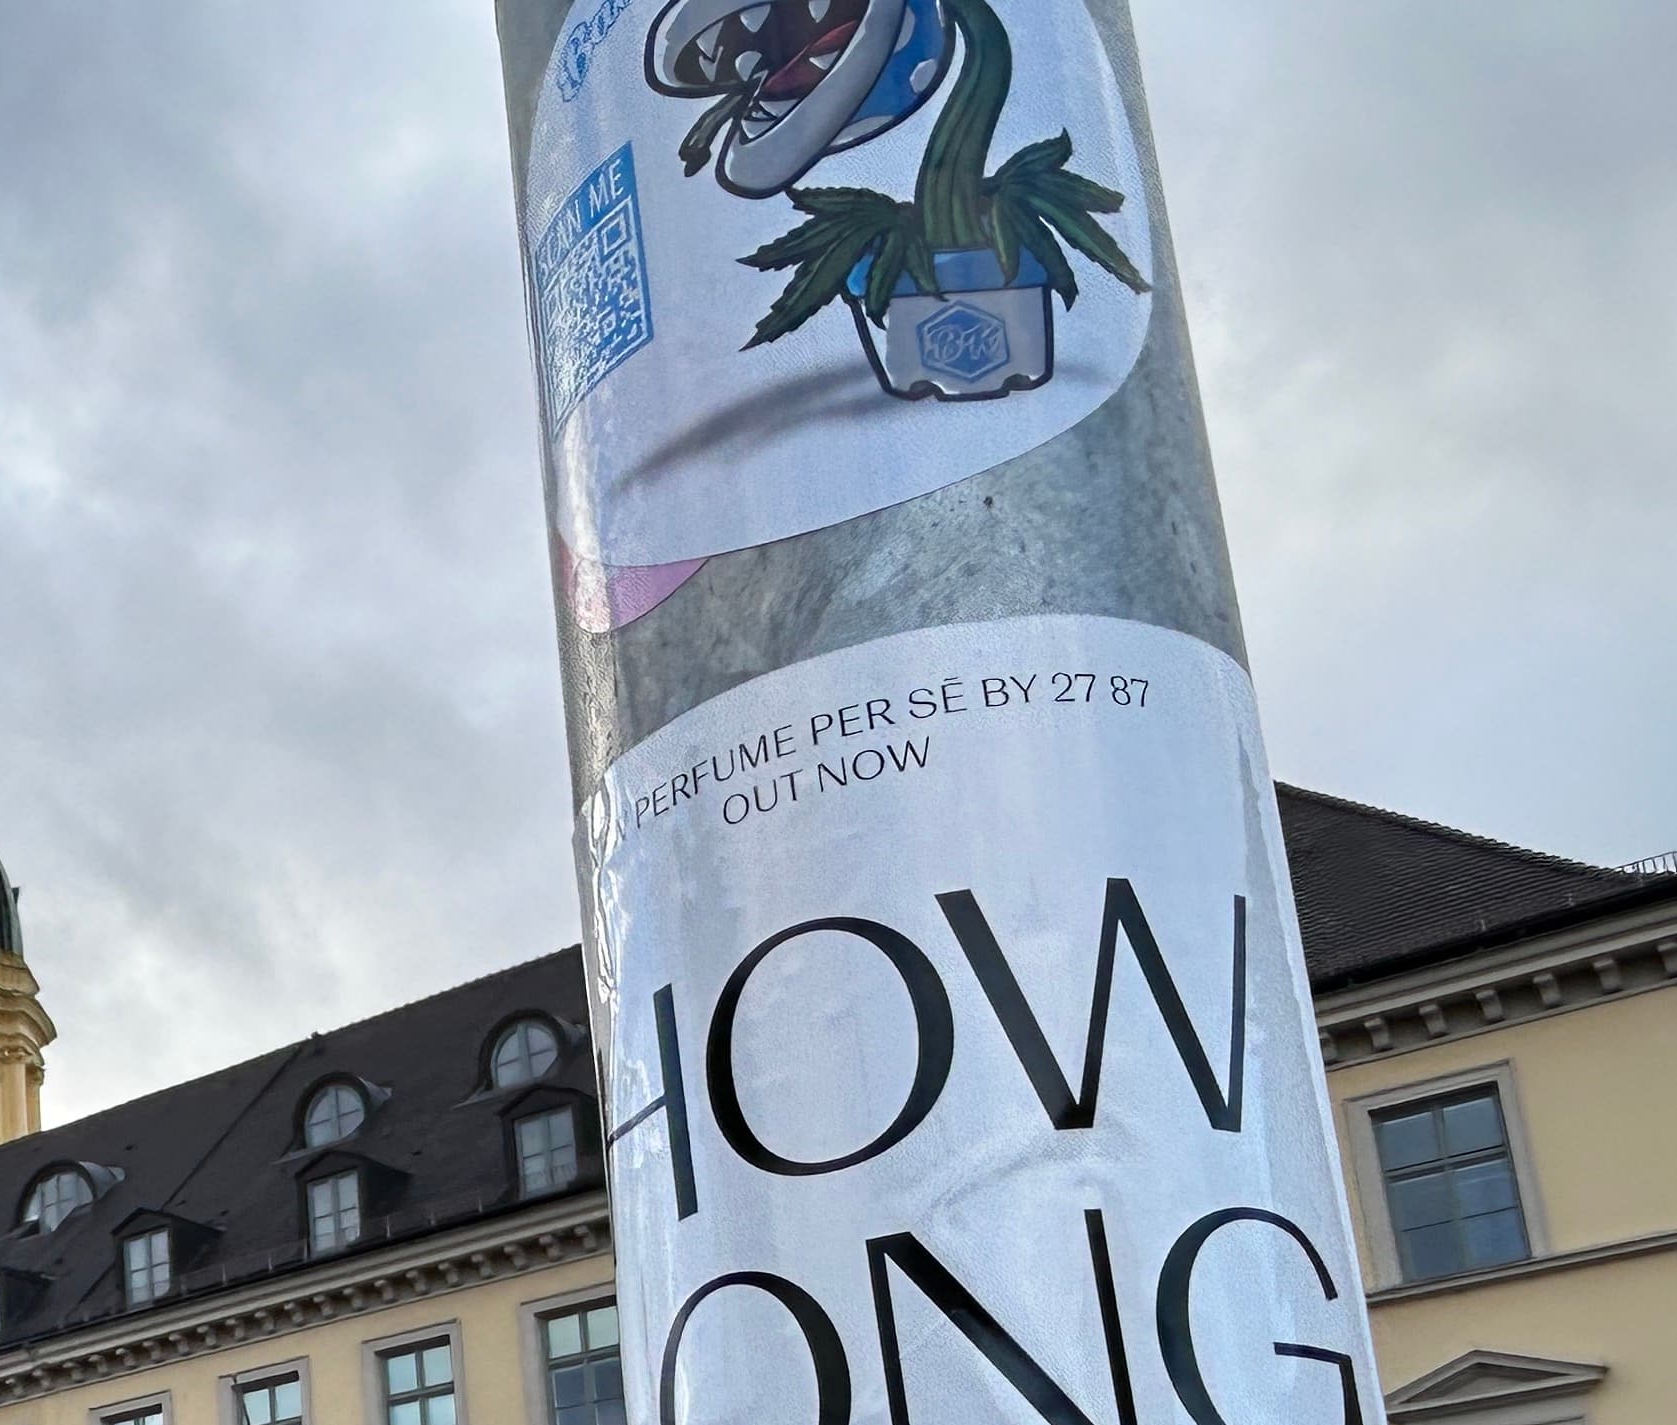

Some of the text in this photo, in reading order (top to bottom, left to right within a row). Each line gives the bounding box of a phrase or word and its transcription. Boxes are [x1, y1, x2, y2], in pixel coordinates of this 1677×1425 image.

[589, 158, 625, 219] ME
[635, 724, 795, 829] PERFUME
[810, 697, 896, 746] PER
[981, 672, 1039, 708] BY
[1051, 672, 1096, 704] 27
[1109, 674, 1150, 707] 87
[722, 736, 931, 826] OUT NOW
